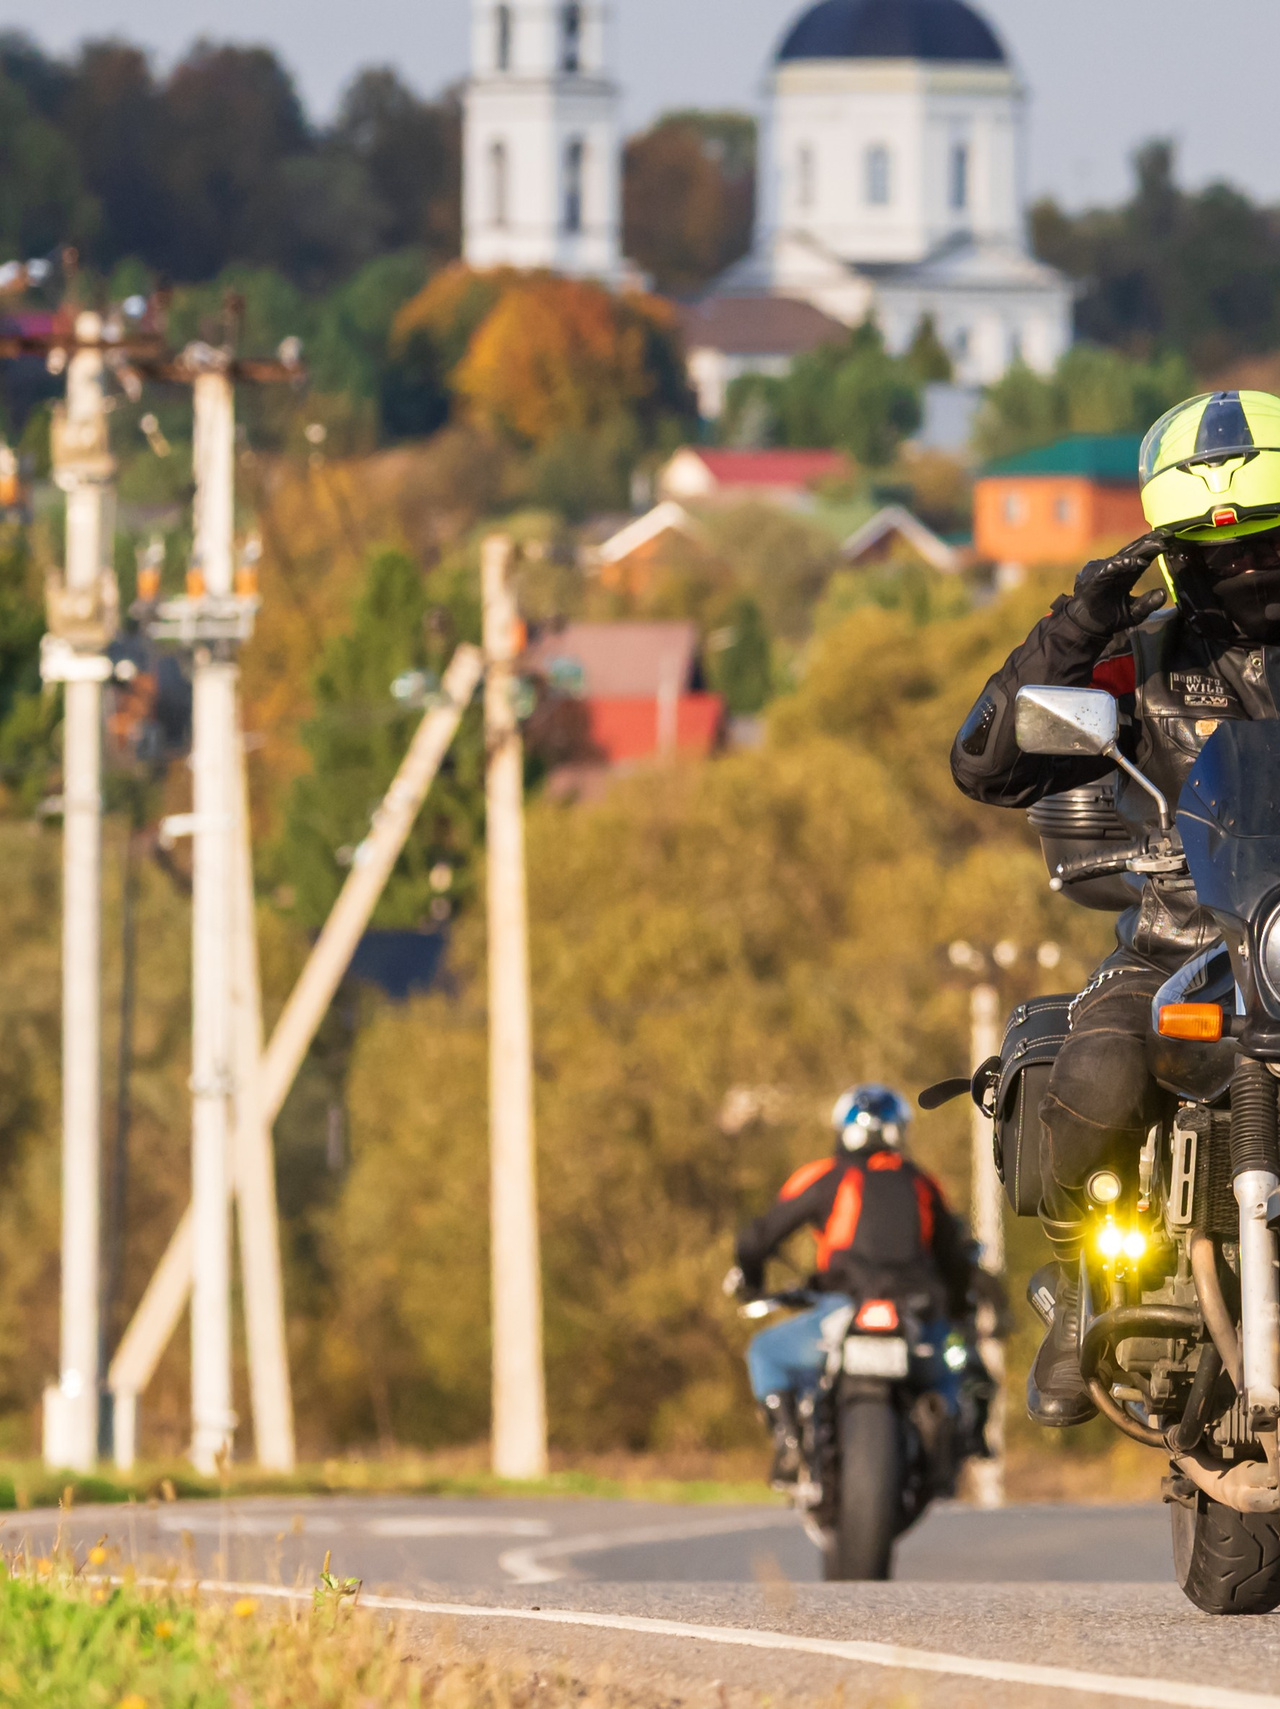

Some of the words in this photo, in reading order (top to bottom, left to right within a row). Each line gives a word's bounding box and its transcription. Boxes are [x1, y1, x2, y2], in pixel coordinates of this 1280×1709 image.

[1173, 672, 1202, 684] BORN
[1205, 677, 1221, 686] TO
[1186, 683, 1224, 694] WILD
